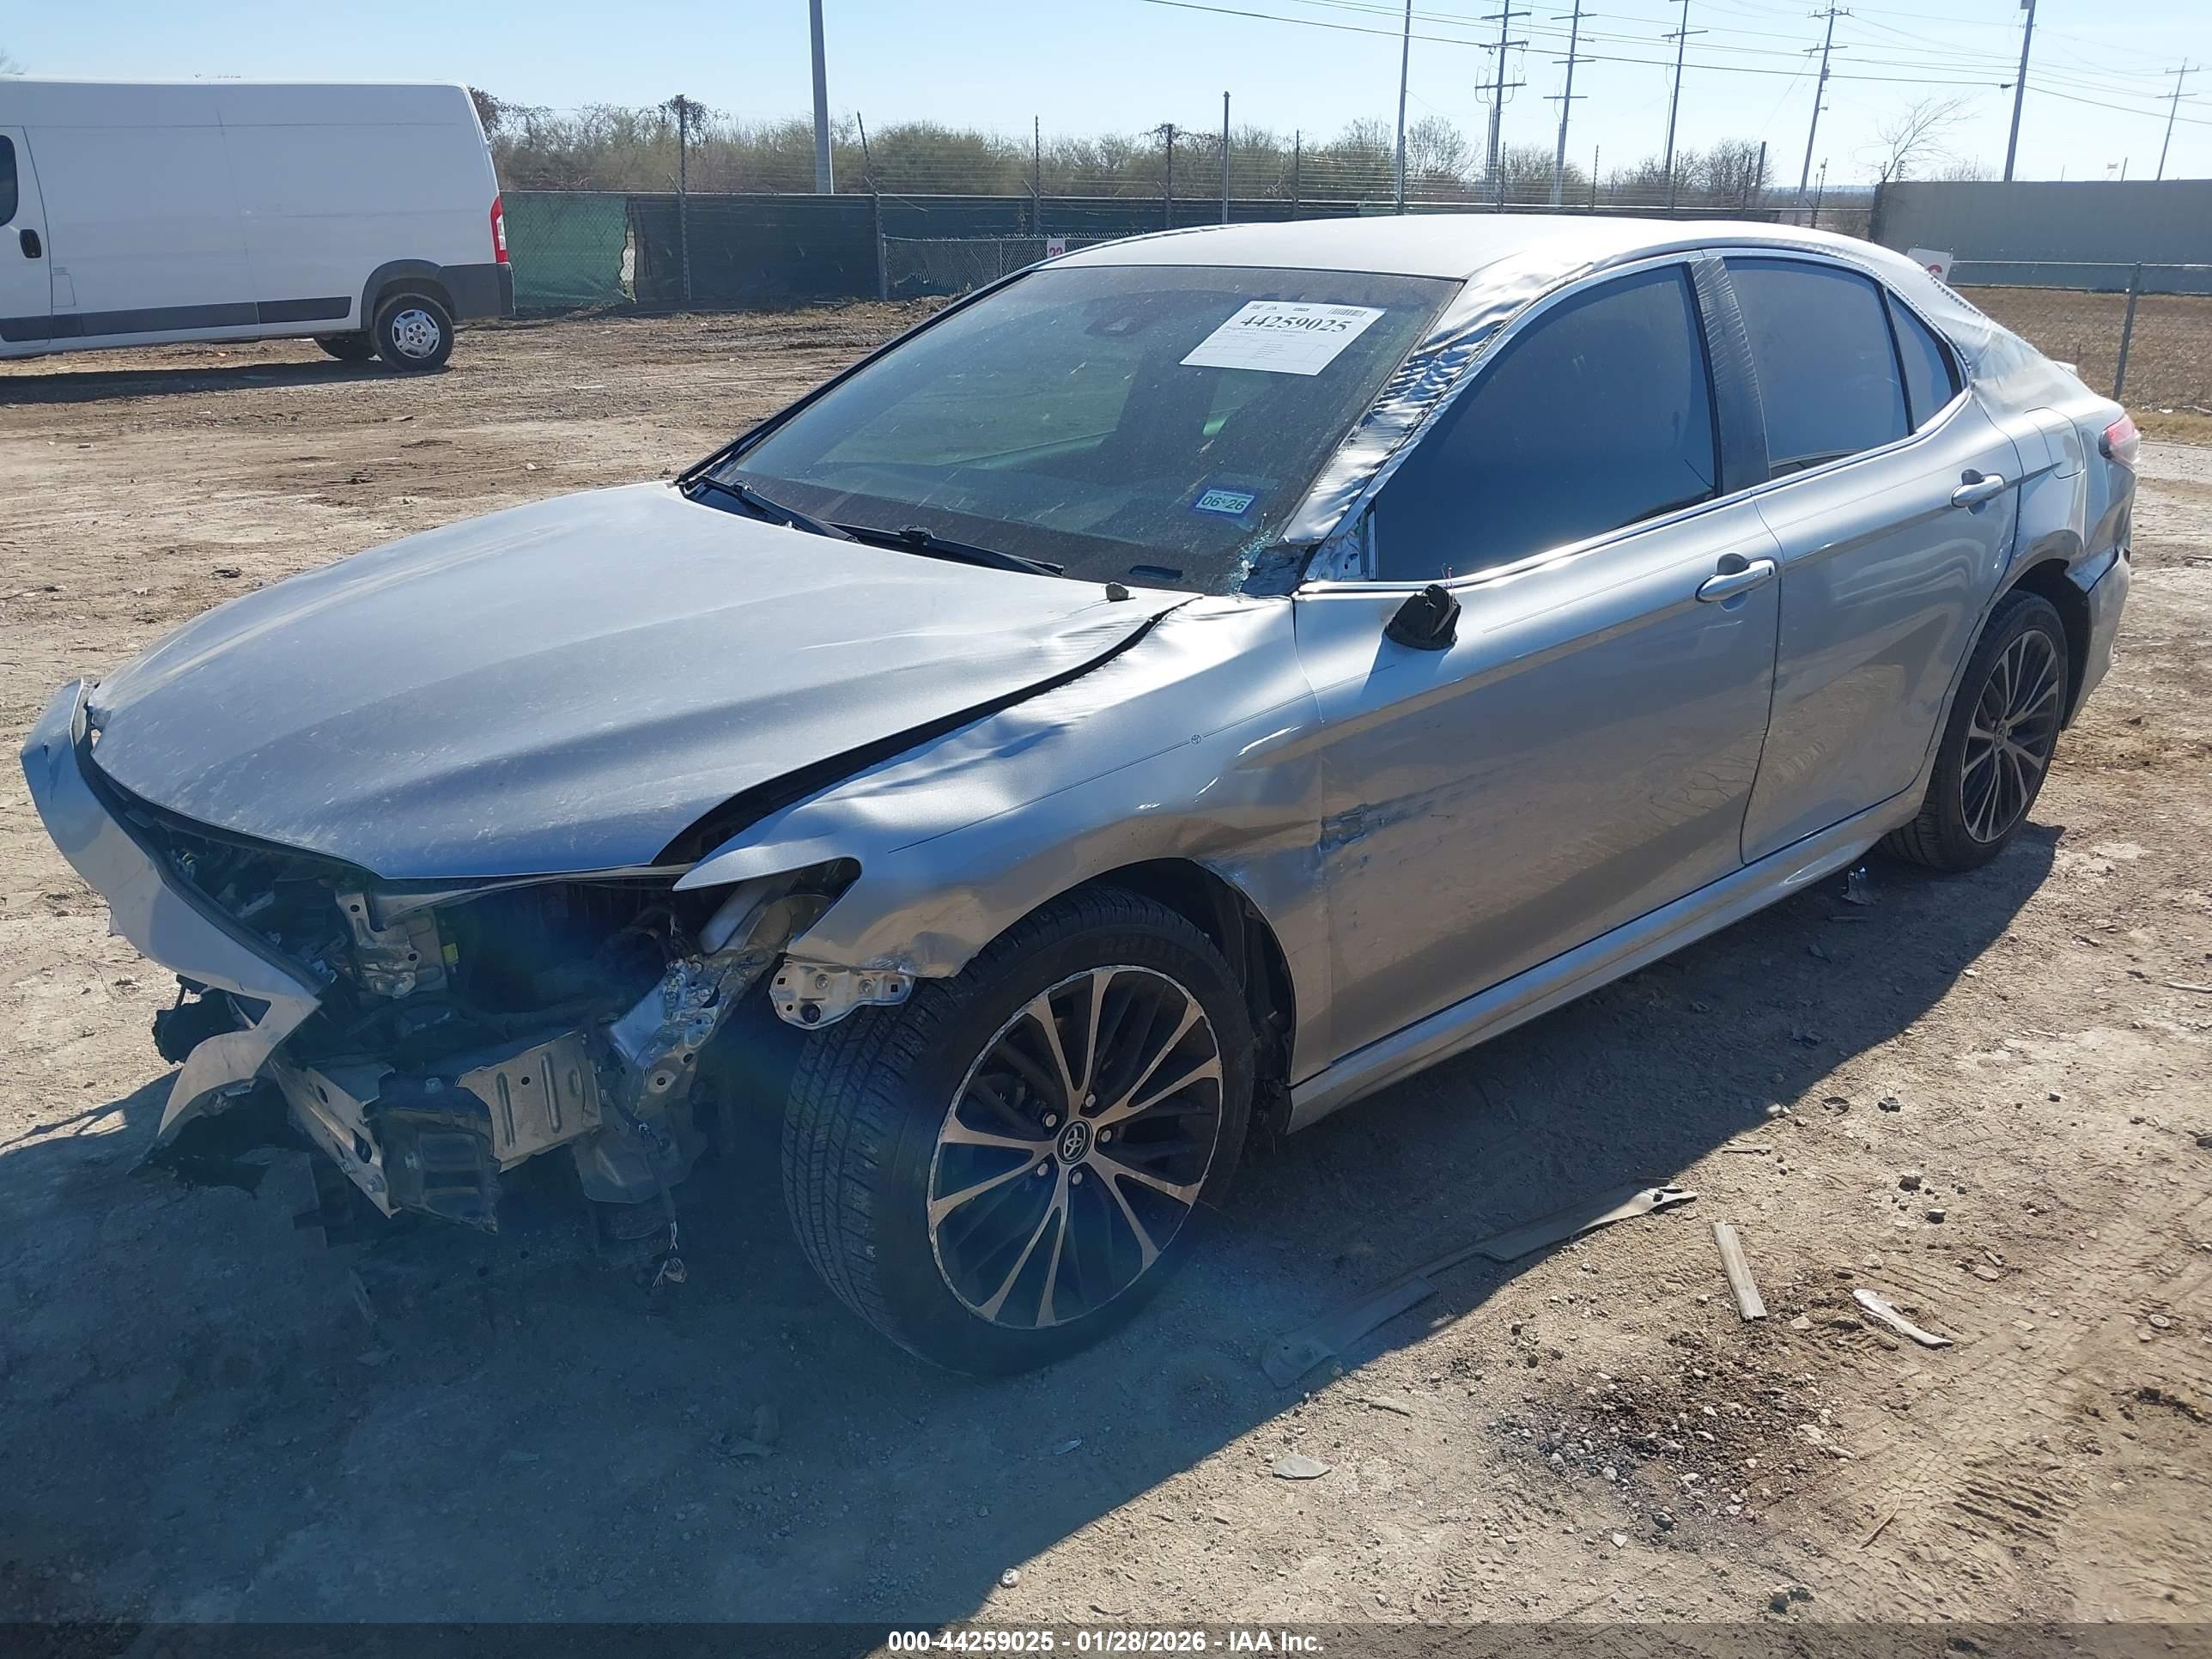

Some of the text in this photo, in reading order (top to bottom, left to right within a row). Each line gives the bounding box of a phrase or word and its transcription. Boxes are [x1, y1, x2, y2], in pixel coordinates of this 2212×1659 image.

[1240, 314, 1352, 332] 44259025
[1201, 496, 1247, 510] 06 26
